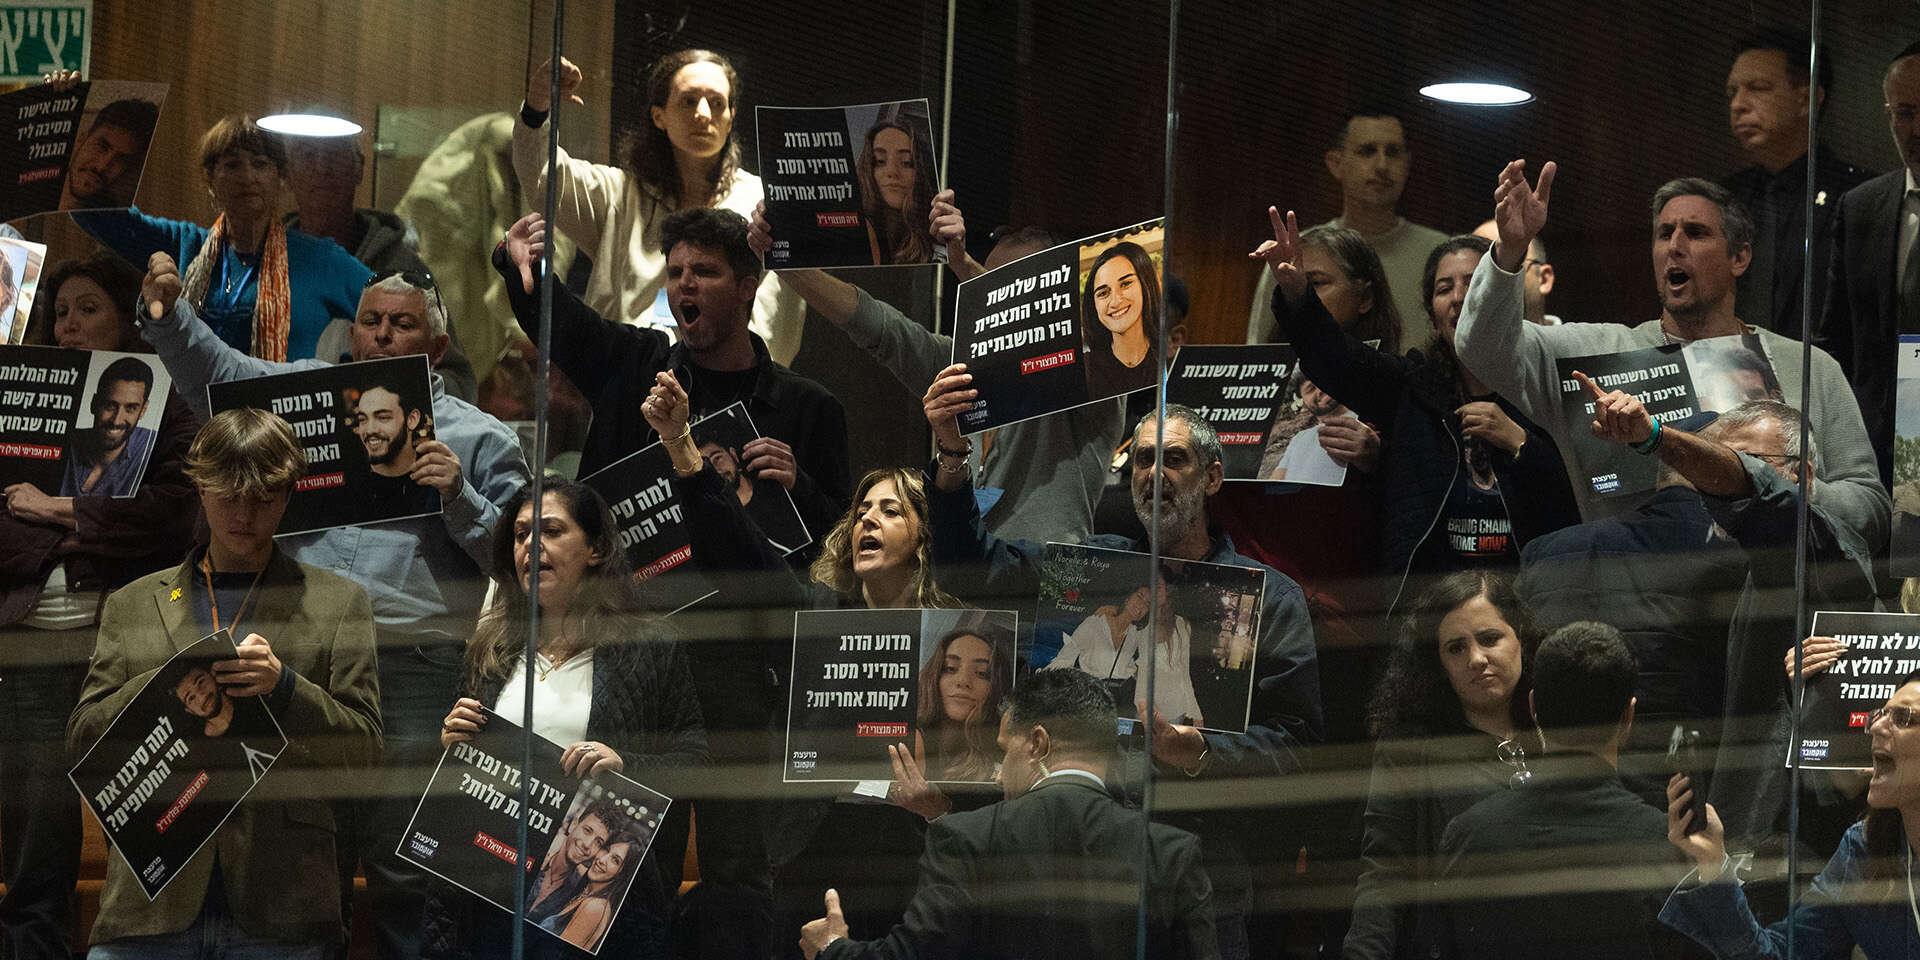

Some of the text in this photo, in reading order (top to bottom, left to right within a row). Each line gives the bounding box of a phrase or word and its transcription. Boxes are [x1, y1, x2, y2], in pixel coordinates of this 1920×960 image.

[18, 97, 78, 120] למה אישרו
[17, 119, 71, 141] מסיבה ליד
[784, 131, 844, 148] מדוע הדרג
[29, 142, 66, 159] הגבול?
[776, 158, 849, 175] המדיני מסרב
[768, 182, 852, 202] לקחת אחריות?
[987, 265, 1071, 307] למה שלושת
[974, 293, 1071, 334] בלוני התצפית
[970, 320, 1072, 359] היו מושבתים?
[1022, 360, 1035, 371] ז"ל
[1036, 355, 1058, 367] מנצורי
[50, 367, 78, 385] למה
[1182, 364, 1287, 380] מי ייתן תשובות
[1600, 369, 1649, 387] משפחתי
[1650, 364, 1680, 379] מדוע
[1222, 383, 1279, 399] לארוסתי
[1654, 384, 1687, 402] צריכה
[3, 391, 73, 410] מבית קשה
[271, 391, 334, 415] מי מנסה
[1209, 407, 1271, 421] שנשארה
[0, 416, 67, 435] מזו שבחוץ
[303, 444, 341, 464] האמ
[1592, 473, 1618, 484] מועצת
[1594, 480, 1619, 491] אוקטובר
[635, 476, 673, 512] למה
[655, 503, 683, 524] חיי
[1448, 518, 1511, 534] BRING CHAIM
[1450, 535, 1507, 551] HOME NOW!
[1055, 600, 1086, 612] Forever
[840, 634, 911, 651] מדוע הדרג
[1880, 633, 1905, 649] לא
[823, 663, 910, 680] המדיני מסרב
[1852, 656, 1893, 678] לחלץ
[806, 688, 909, 711] לקחת אחריות?
[1840, 683, 1896, 699] הנובה?
[1852, 713, 1865, 724] ז"ל
[870, 725, 892, 734] מנצורי
[1802, 739, 1829, 748] מועצת
[793, 751, 818, 760] מועצת
[1801, 748, 1827, 758] אוקטובר
[95, 716, 174, 811] למה סיכנו את
[793, 761, 816, 769] אוקטובר
[453, 742, 566, 809] איך הדר נפרצה
[106, 738, 189, 832] חיי החטופים?
[459, 773, 553, 834] בכזת קלות?
[414, 831, 439, 848] מועצת
[411, 840, 434, 857] אוקטובר
[143, 856, 162, 878] מועצת
